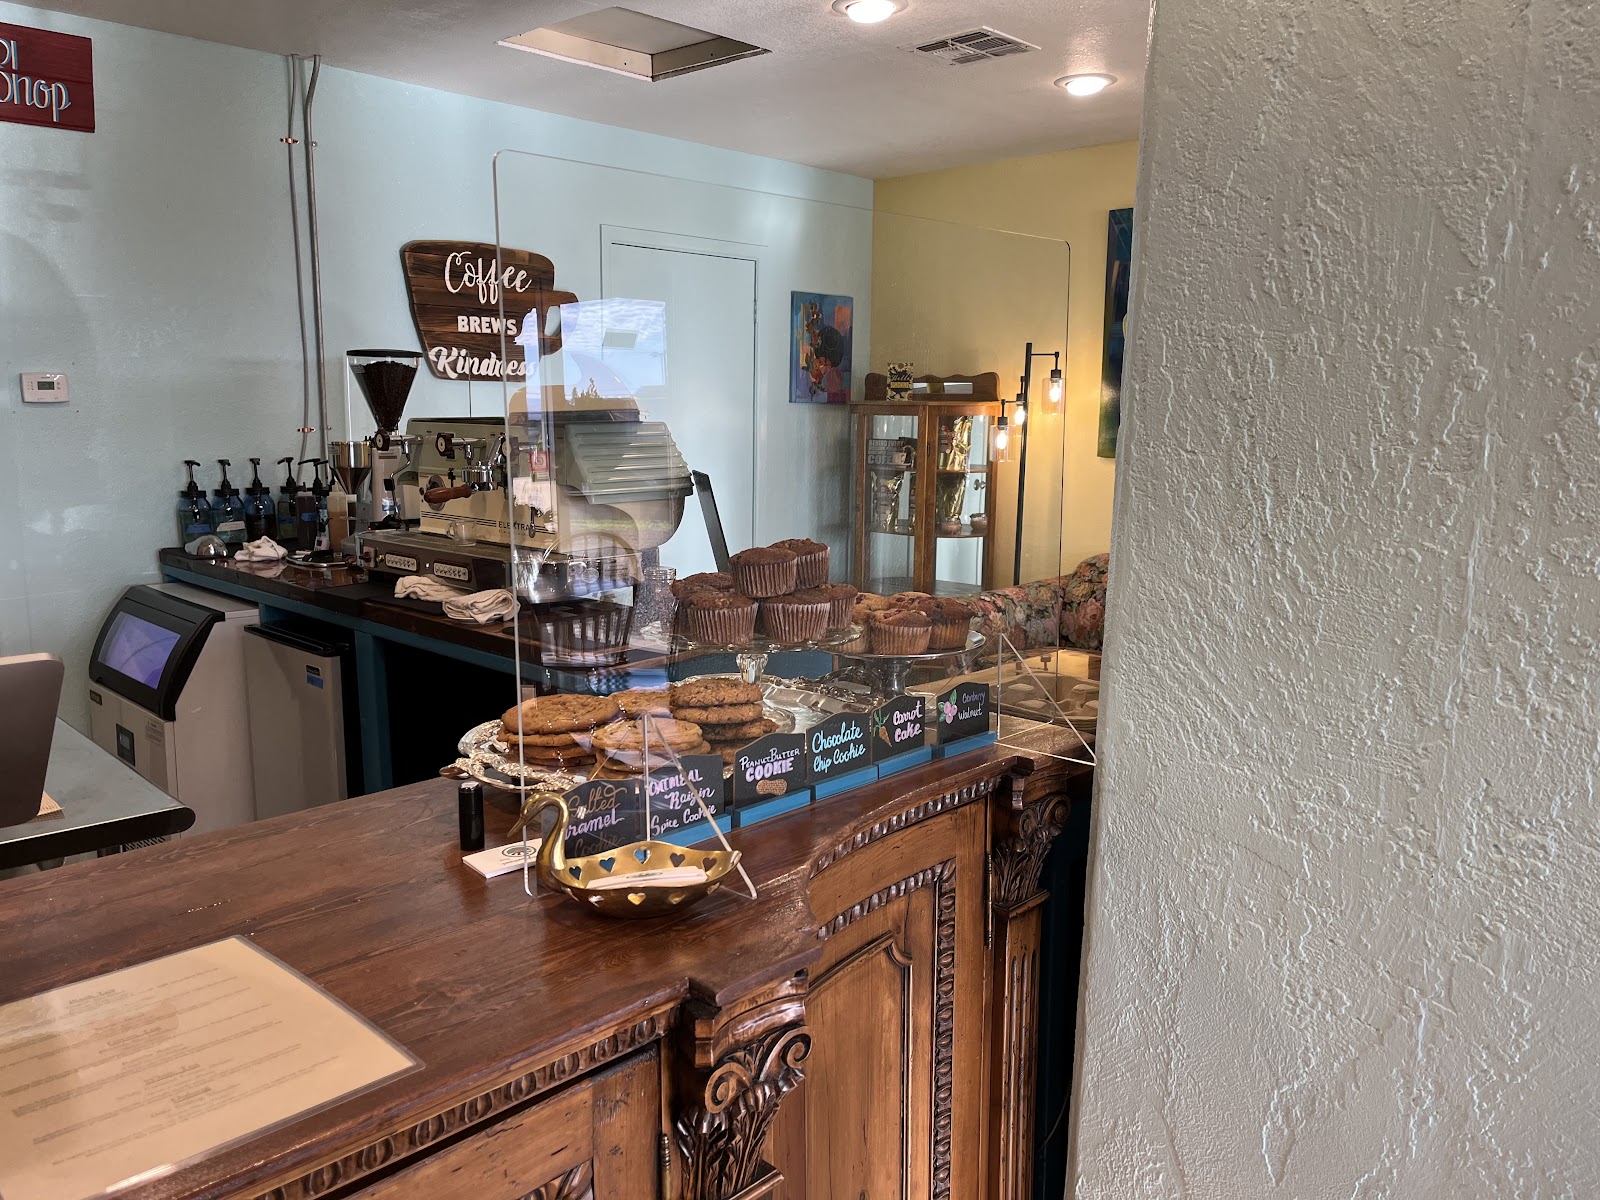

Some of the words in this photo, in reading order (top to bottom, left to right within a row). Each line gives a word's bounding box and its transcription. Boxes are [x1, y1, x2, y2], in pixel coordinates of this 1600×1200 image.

[444, 250, 532, 305] Coffee
[457, 315, 518, 335] BREWS
[428, 346, 536, 379] Kindness
[893, 700, 923, 726] Carrot
[811, 720, 864, 754] Chocolate
[894, 722, 923, 743] Cake
[745, 757, 794, 783] COOKIE
[813, 756, 832, 774] Chip
[833, 743, 867, 765] Cookie
[649, 768, 703, 796] OATMEAL
[650, 814, 680, 837] Spice
[682, 804, 717, 824] Cookie
